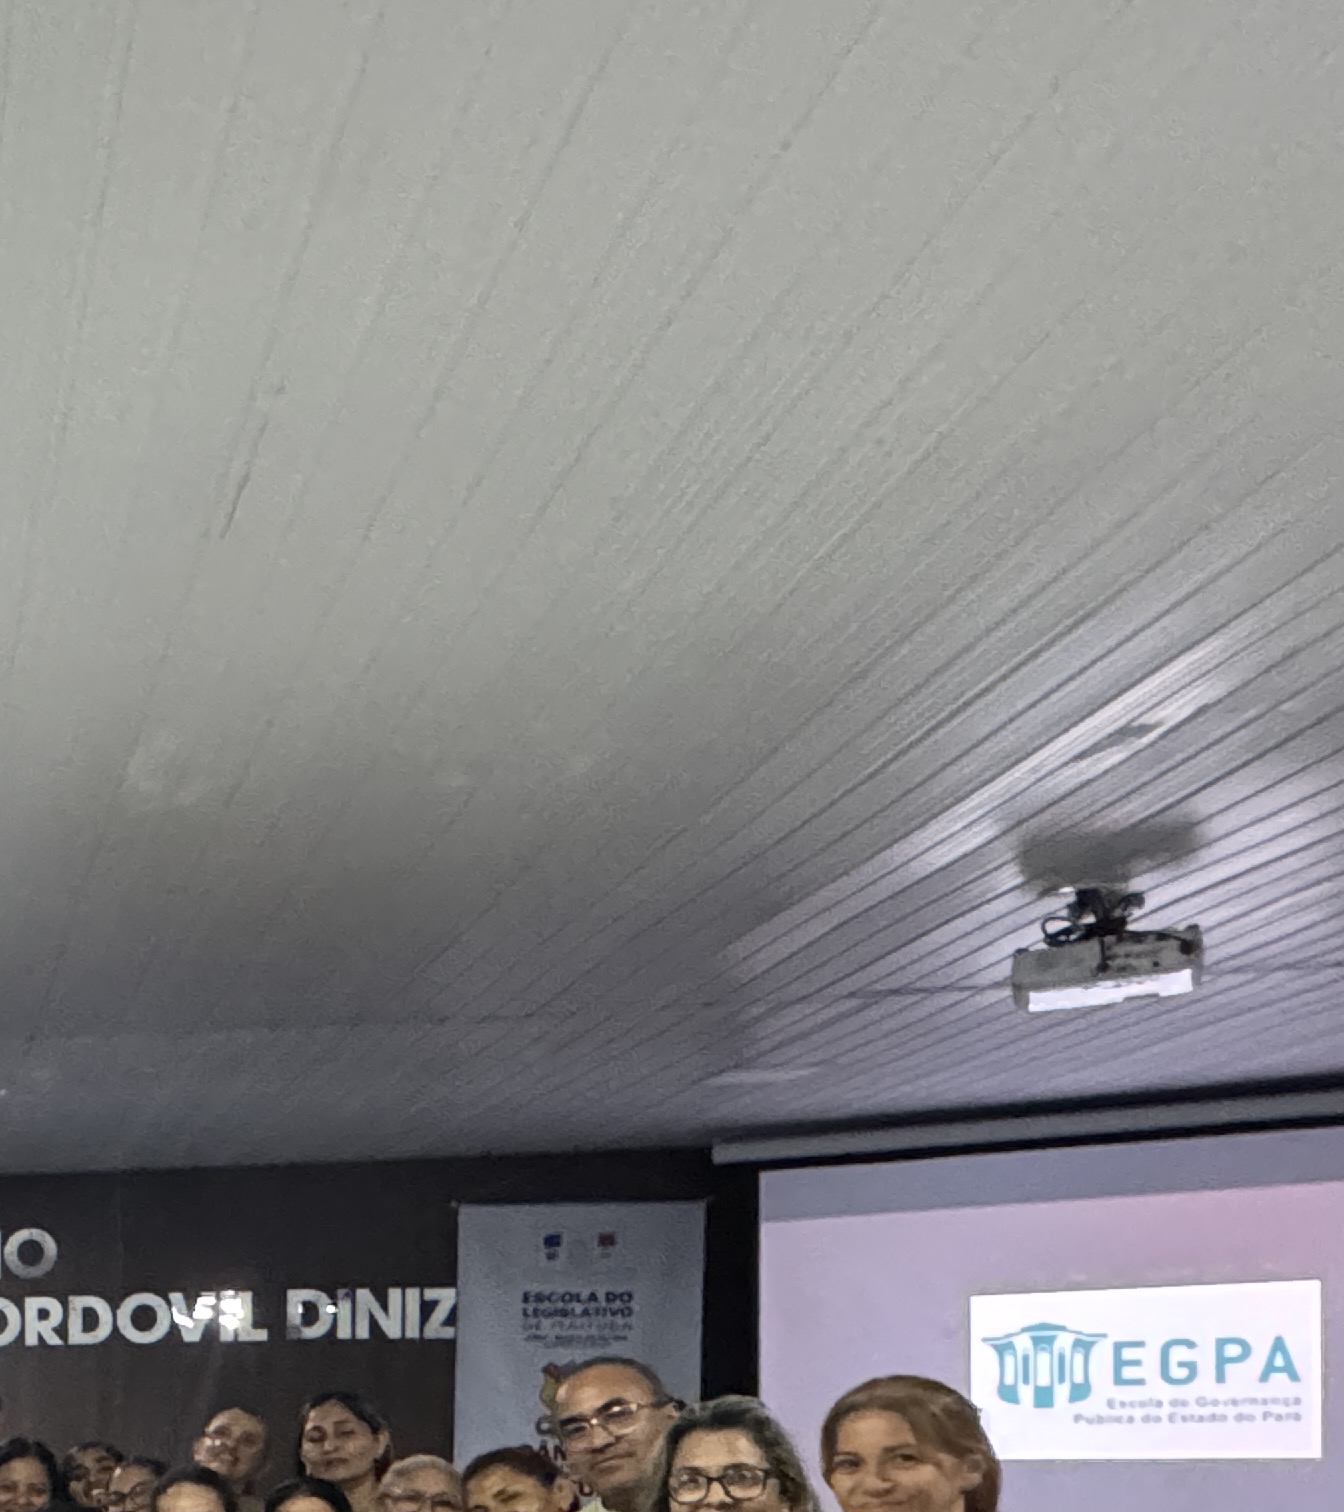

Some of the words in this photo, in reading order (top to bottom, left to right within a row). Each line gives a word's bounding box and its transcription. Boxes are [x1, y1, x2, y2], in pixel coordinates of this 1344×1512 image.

[522, 1291, 598, 1303] ESCOLA
[605, 1291, 633, 1303] DO
[286, 1286, 457, 1340] DINIZ
[521, 1306, 633, 1318] LEGISLATIVO
[1112, 1335, 1302, 1386] EGPA
[1106, 1397, 1163, 1410] Escola
[1168, 1412, 1228, 1424] Estado
